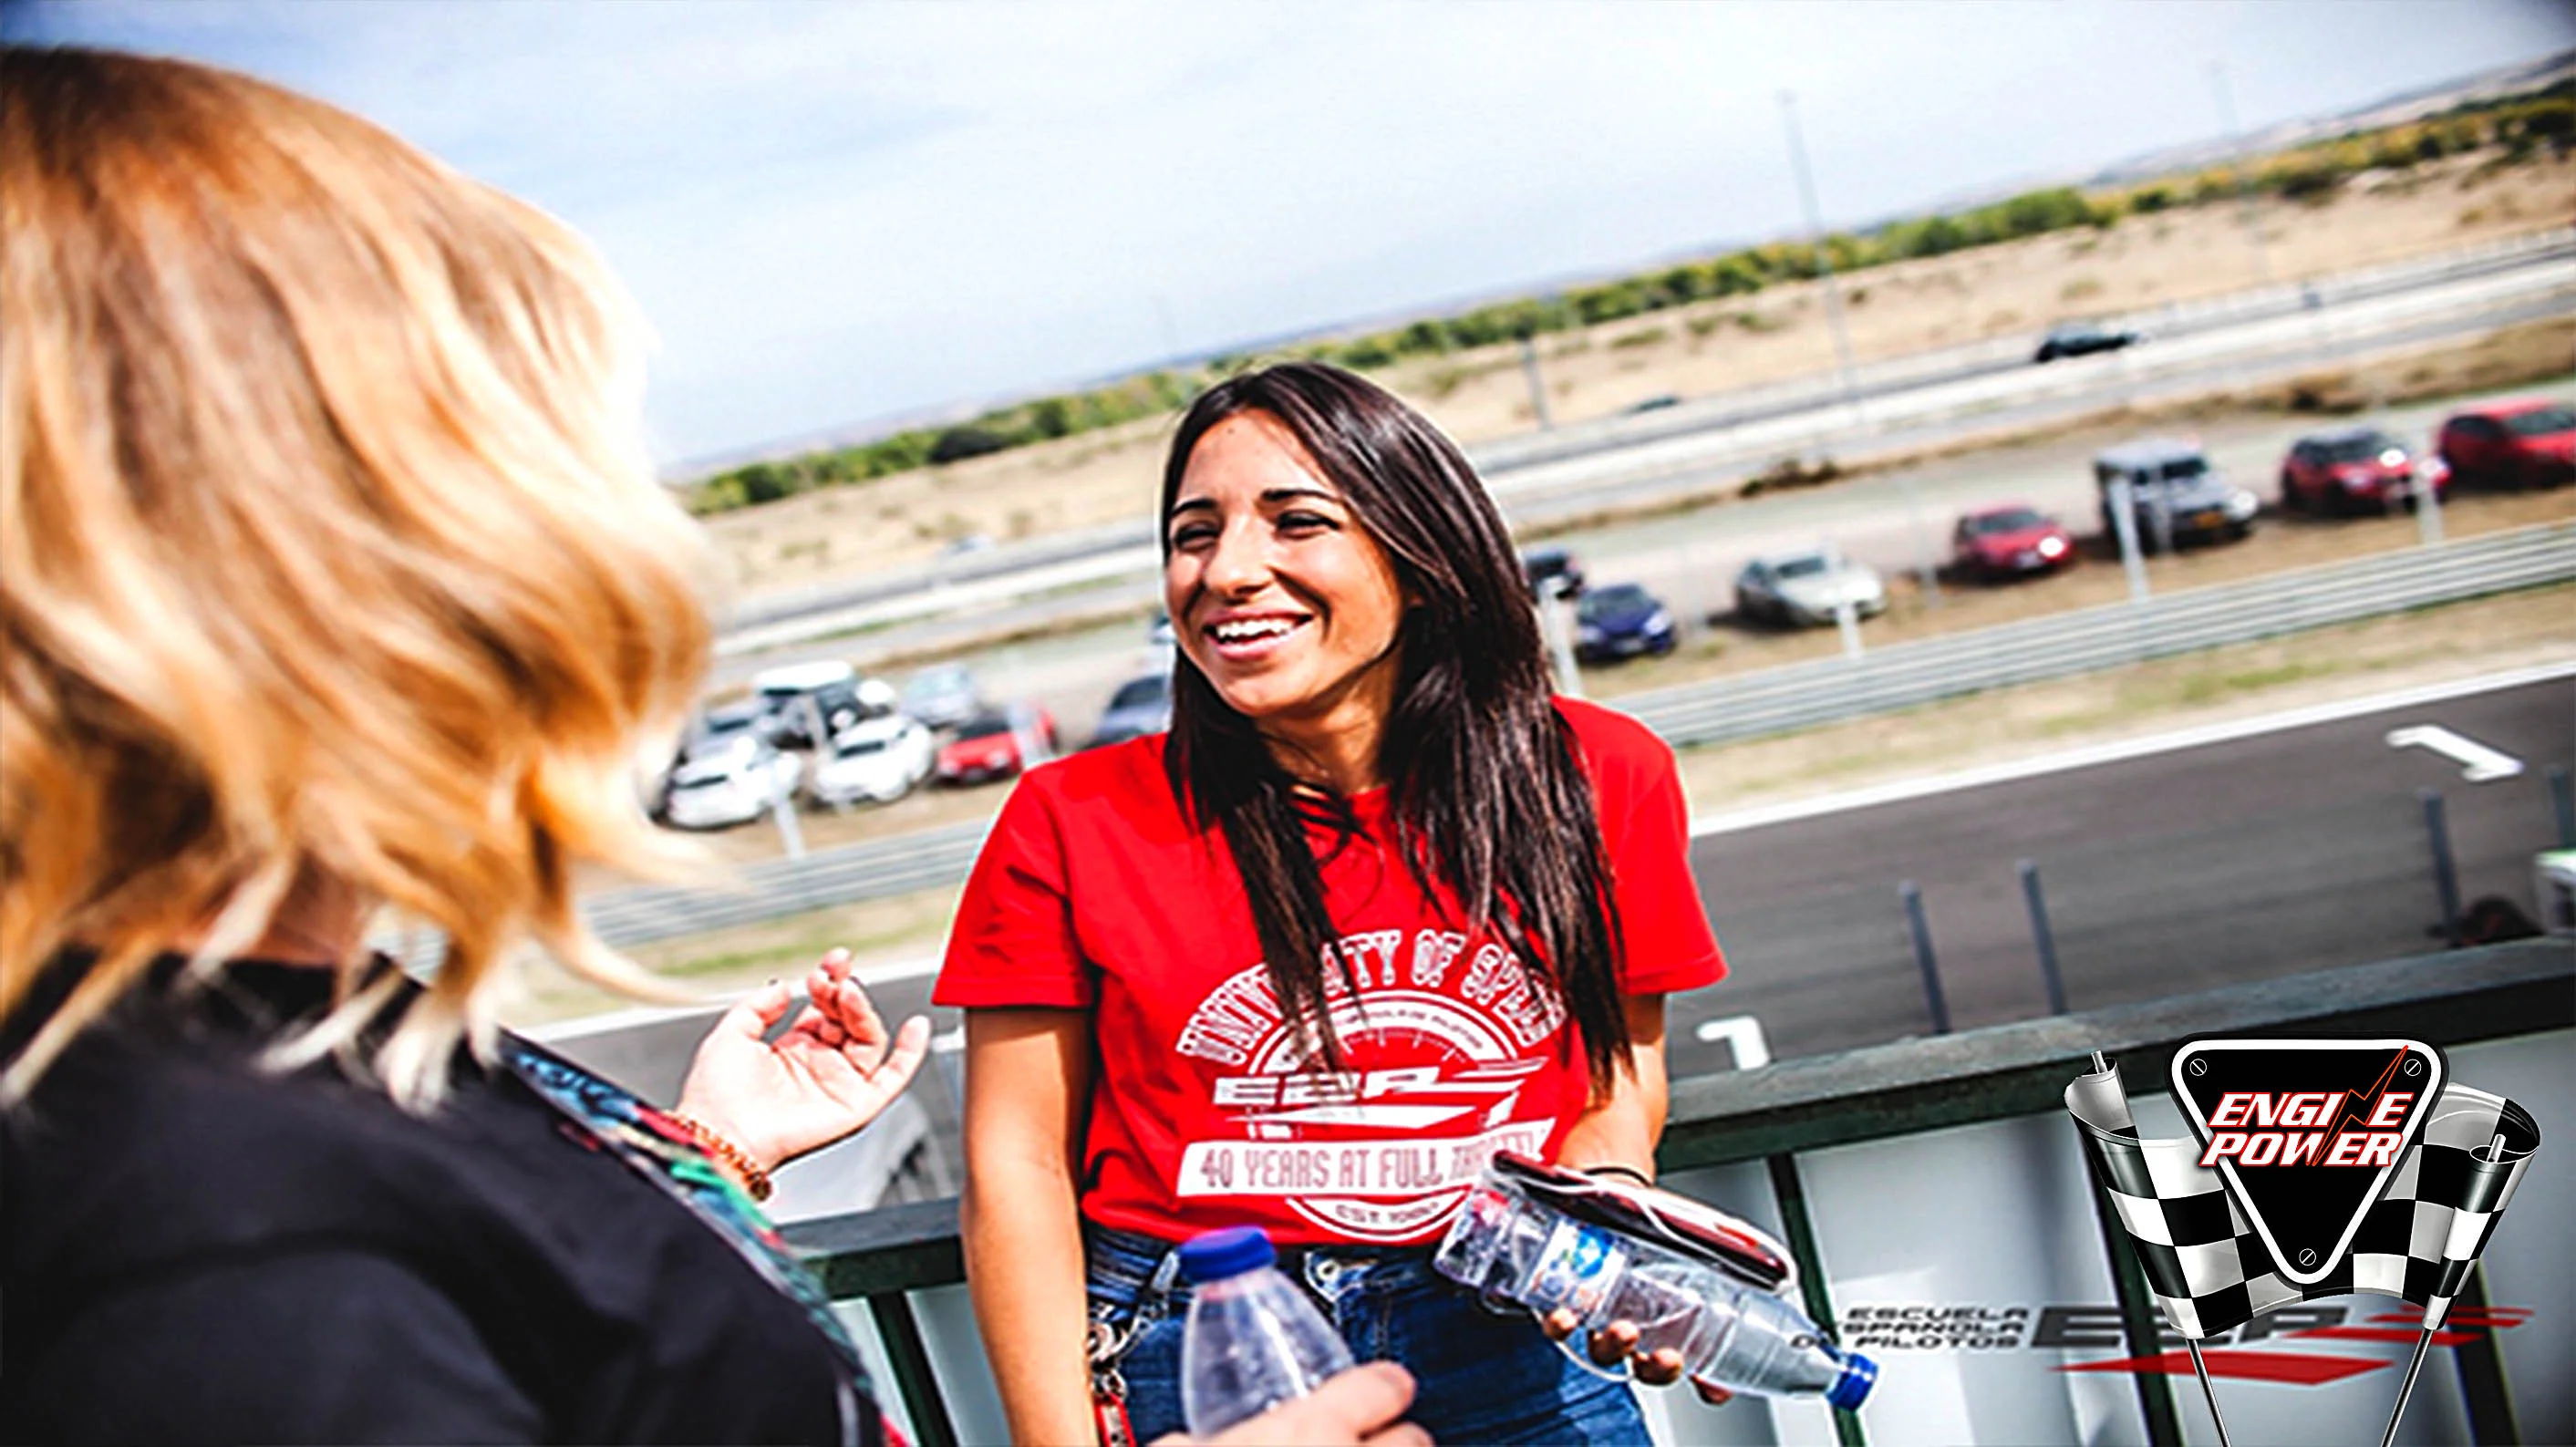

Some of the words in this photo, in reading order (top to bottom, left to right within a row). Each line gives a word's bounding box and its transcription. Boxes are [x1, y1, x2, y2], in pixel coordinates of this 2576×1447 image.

[1411, 928, 1465, 987] OF
[1200, 1148, 1233, 1188] 40
[1245, 1148, 1330, 1188] YEARS
[1339, 1148, 1370, 1188] AT
[1379, 1147, 1443, 1188] FULL
